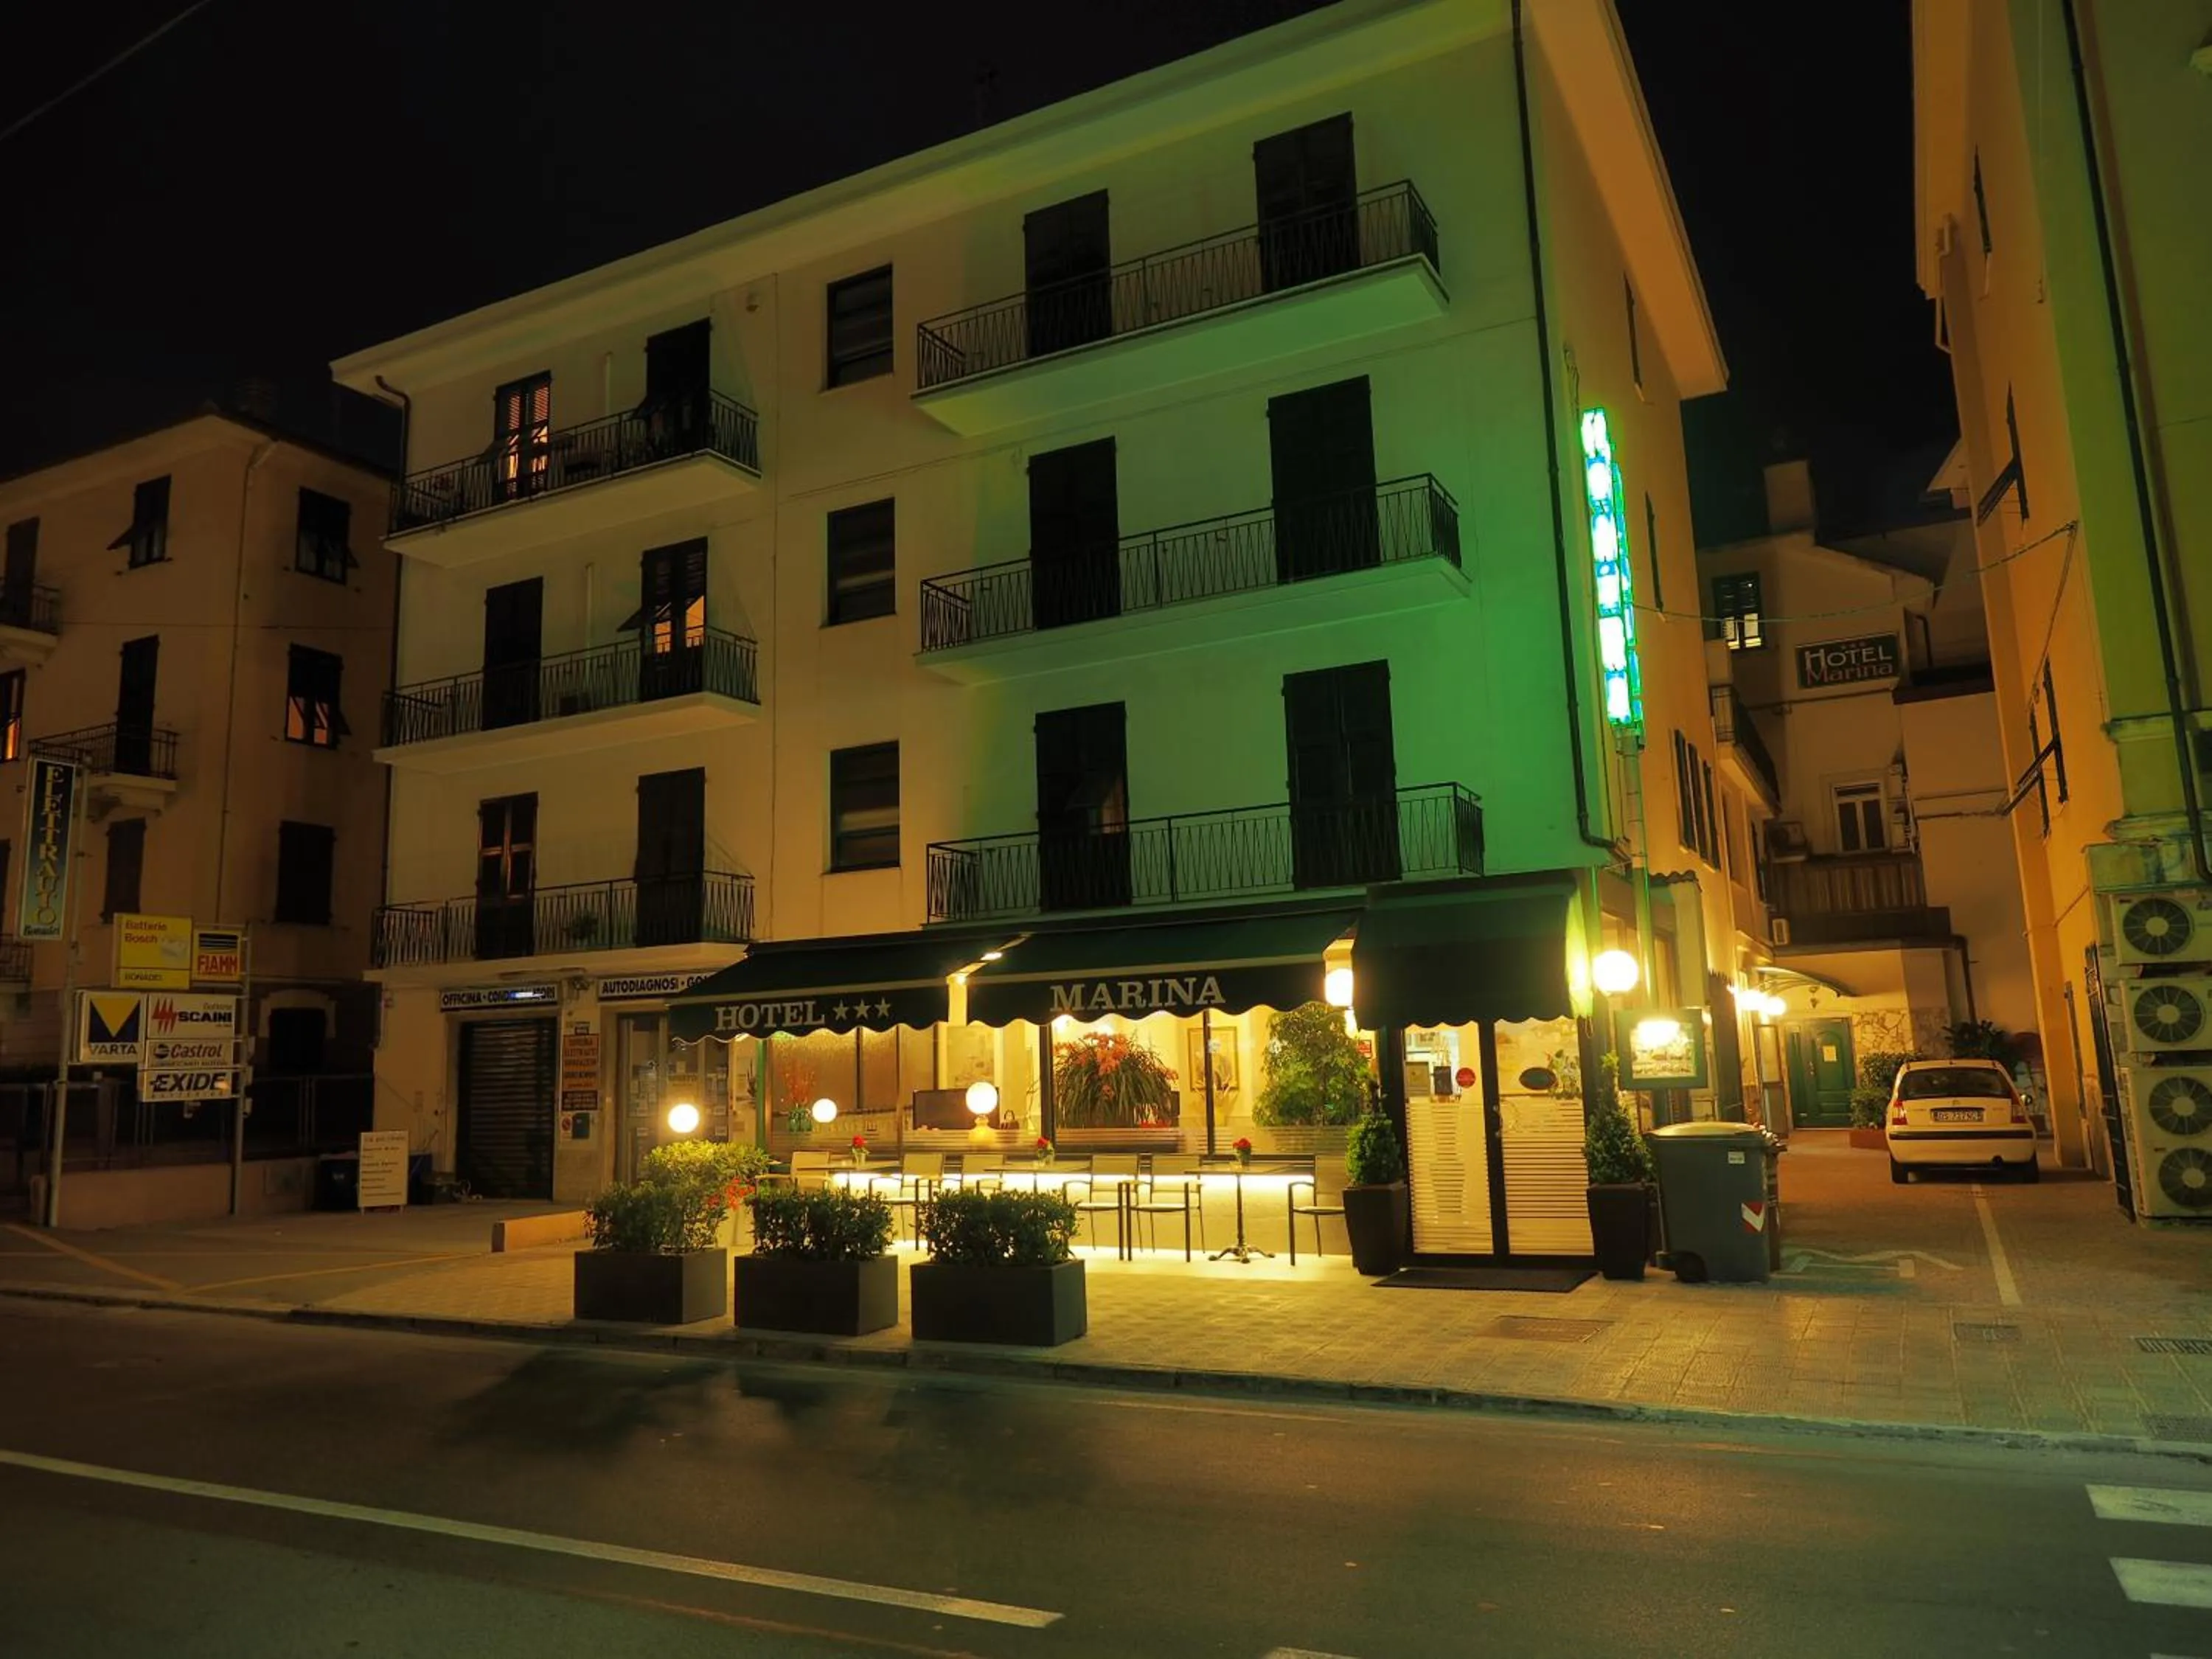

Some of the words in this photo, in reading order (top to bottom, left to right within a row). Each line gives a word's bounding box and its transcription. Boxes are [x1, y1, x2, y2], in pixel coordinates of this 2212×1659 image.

[1805, 645, 1892, 667] HOTEL
[1806, 662, 1893, 686] Marina
[125, 933, 158, 945] Bosch
[198, 955, 237, 975] FIAMM
[602, 977, 678, 994] AUTODIAGNOSI
[1048, 975, 1225, 1012] MARINA
[442, 992, 481, 1006] OFFICINA
[178, 1011, 232, 1023] SCAINI
[714, 1000, 825, 1031] HOTEL
[90, 1044, 137, 1055] VARTA
[170, 1044, 222, 1059] Castrol
[150, 1073, 226, 1092] EXIDE
